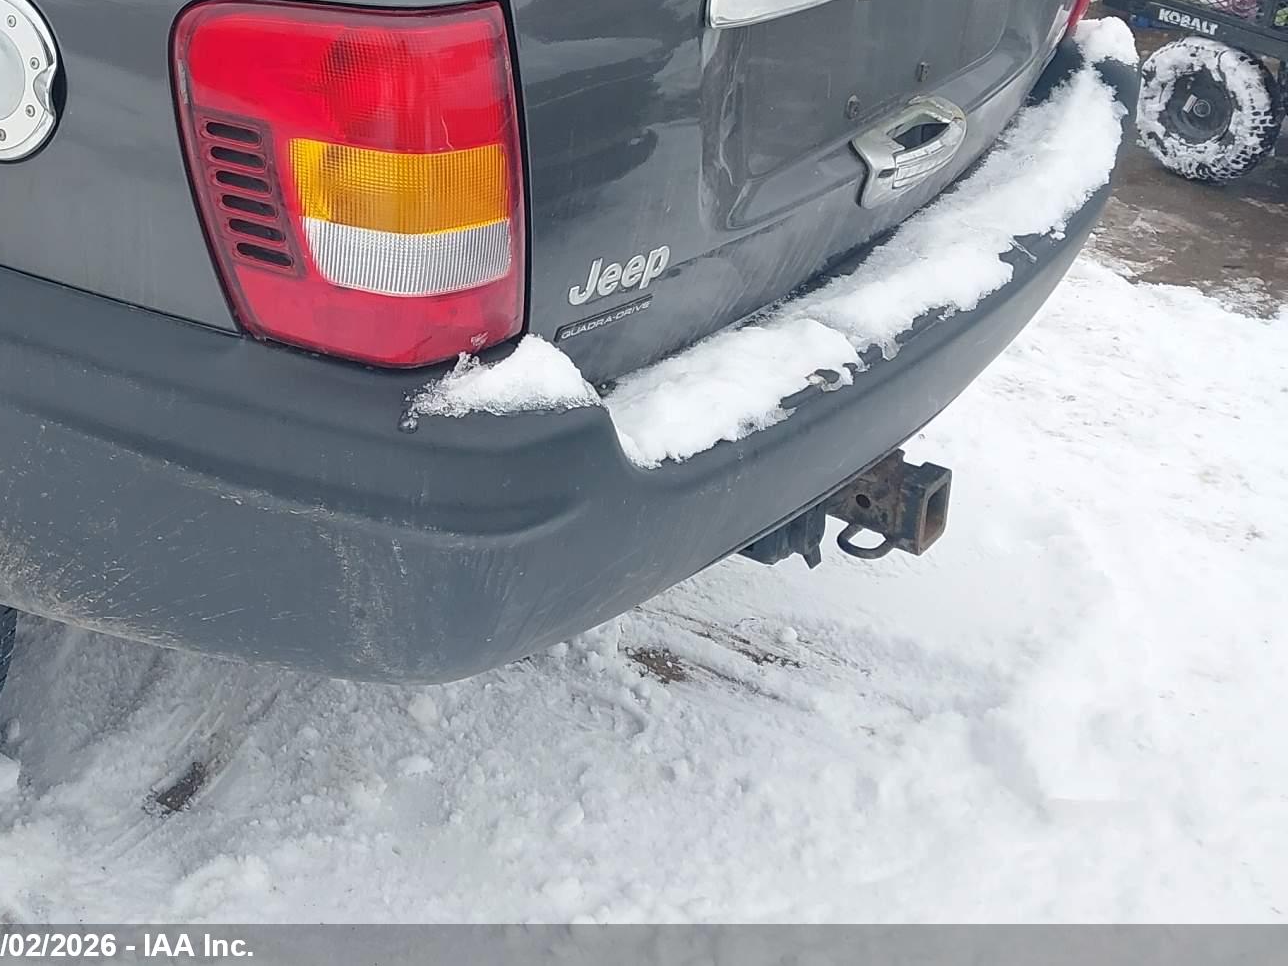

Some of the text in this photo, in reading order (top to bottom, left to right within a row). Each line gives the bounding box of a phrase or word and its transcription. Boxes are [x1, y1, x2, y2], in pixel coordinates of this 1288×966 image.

[1158, 7, 1219, 36] KOBALT
[568, 245, 671, 306] Jeep
[561, 300, 653, 340] QUADRA-DRIVE
